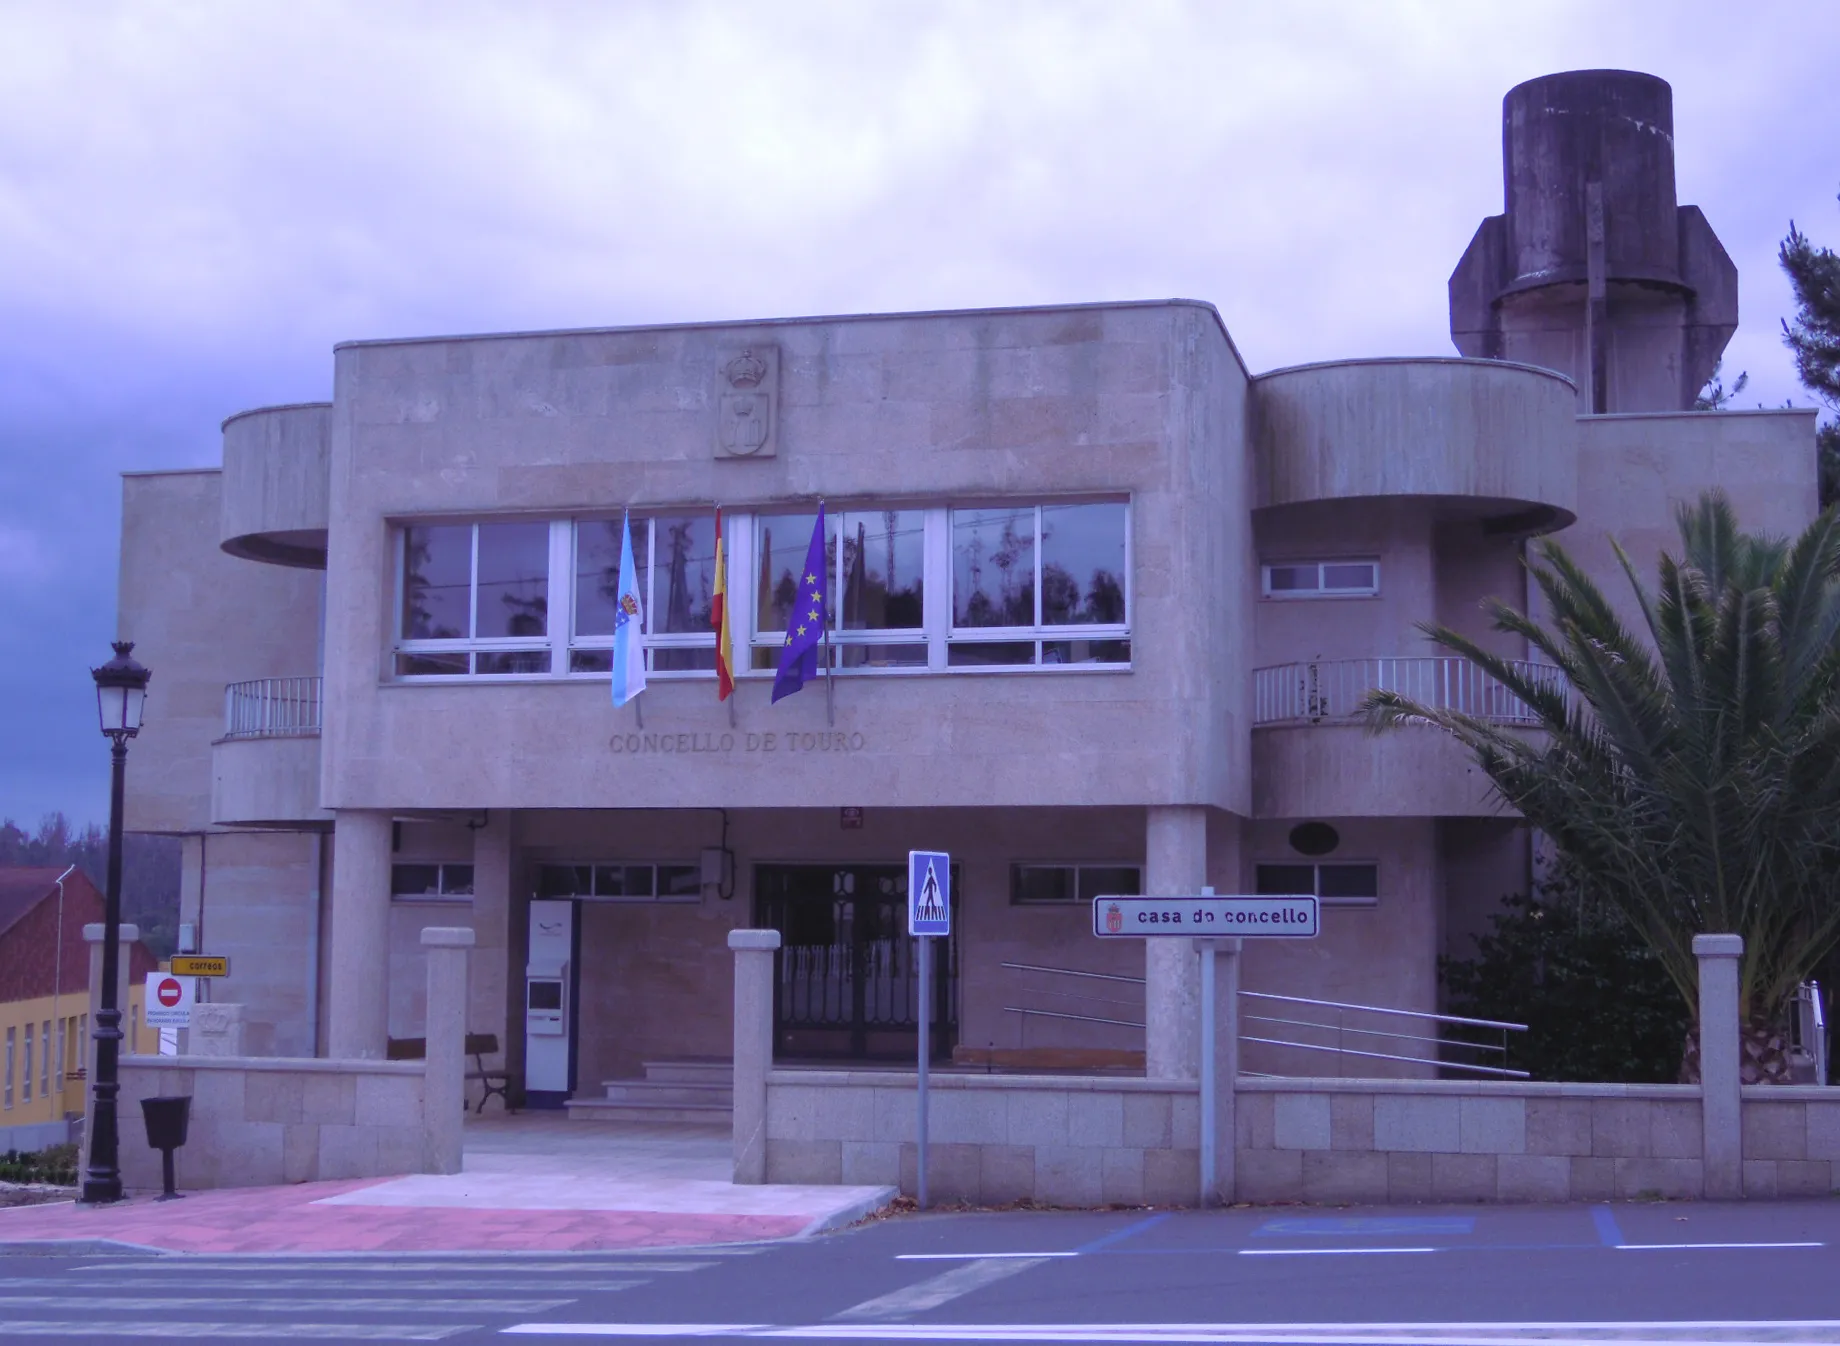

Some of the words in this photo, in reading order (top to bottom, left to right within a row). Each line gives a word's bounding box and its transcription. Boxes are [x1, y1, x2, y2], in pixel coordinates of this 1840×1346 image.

[609, 733, 735, 753] CONCELLO
[745, 732, 777, 752] DE
[785, 731, 865, 752] TOURO
[1138, 911, 1182, 923] casa
[1193, 909, 1215, 923] do
[1225, 908, 1308, 923] concello
[190, 962, 223, 970] correos
